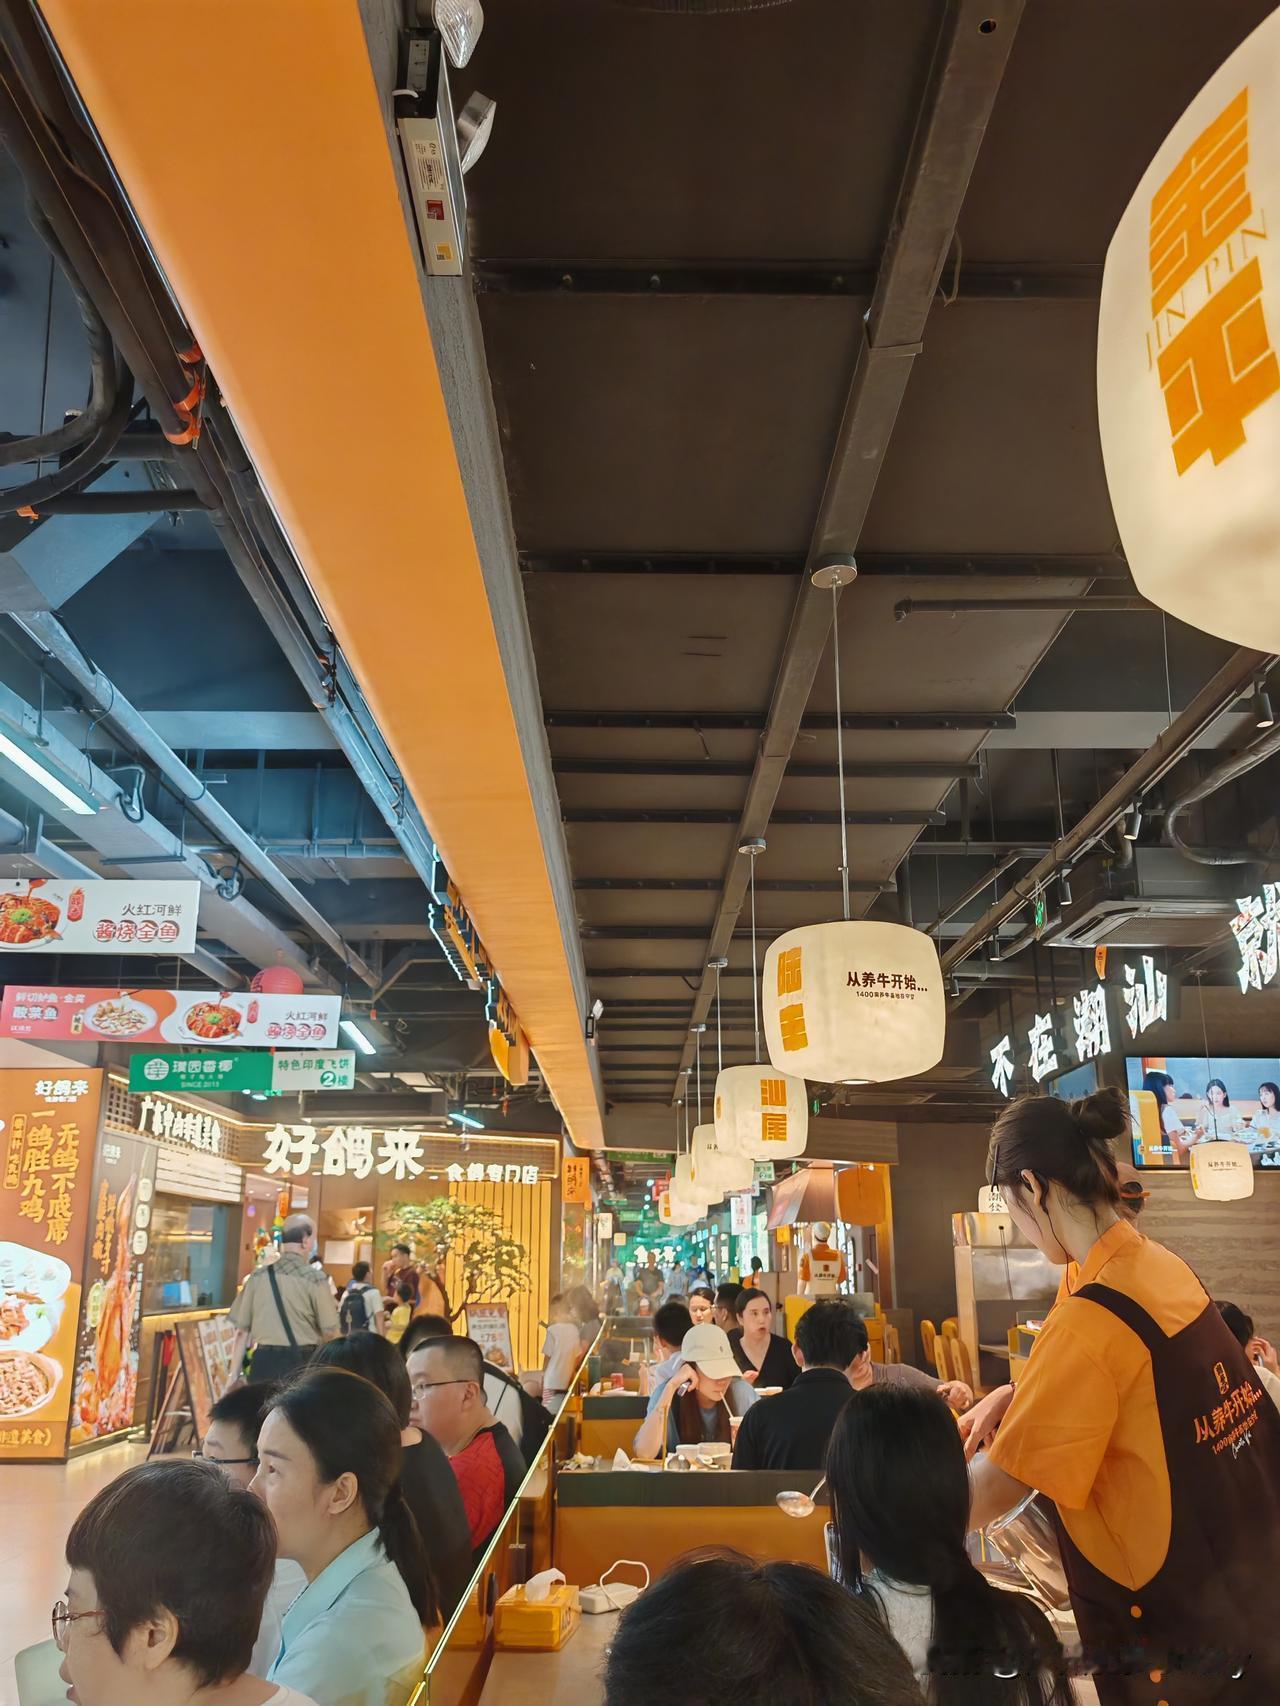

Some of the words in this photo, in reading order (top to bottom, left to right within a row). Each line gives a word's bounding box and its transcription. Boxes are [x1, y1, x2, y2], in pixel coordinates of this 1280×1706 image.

[121, 903, 182, 917] 火红河鲜
[95, 921, 178, 942] 酱烧全鱼
[12, 1006, 59, 1020] 酸菜鱼
[286, 1010, 328, 1021] 火红河鲜
[990, 955, 1168, 1098] 不在潮汕
[278, 1058, 350, 1071] 特色印度飞饼
[34, 1079, 89, 1096] 好鸽来
[181, 1081, 202, 1089] SINCE
[262, 1123, 425, 1180] 好鸽来
[18, 1109, 57, 1223] 一鸽胜九鸡
[44, 1122, 81, 1246] 无鸽不成席
